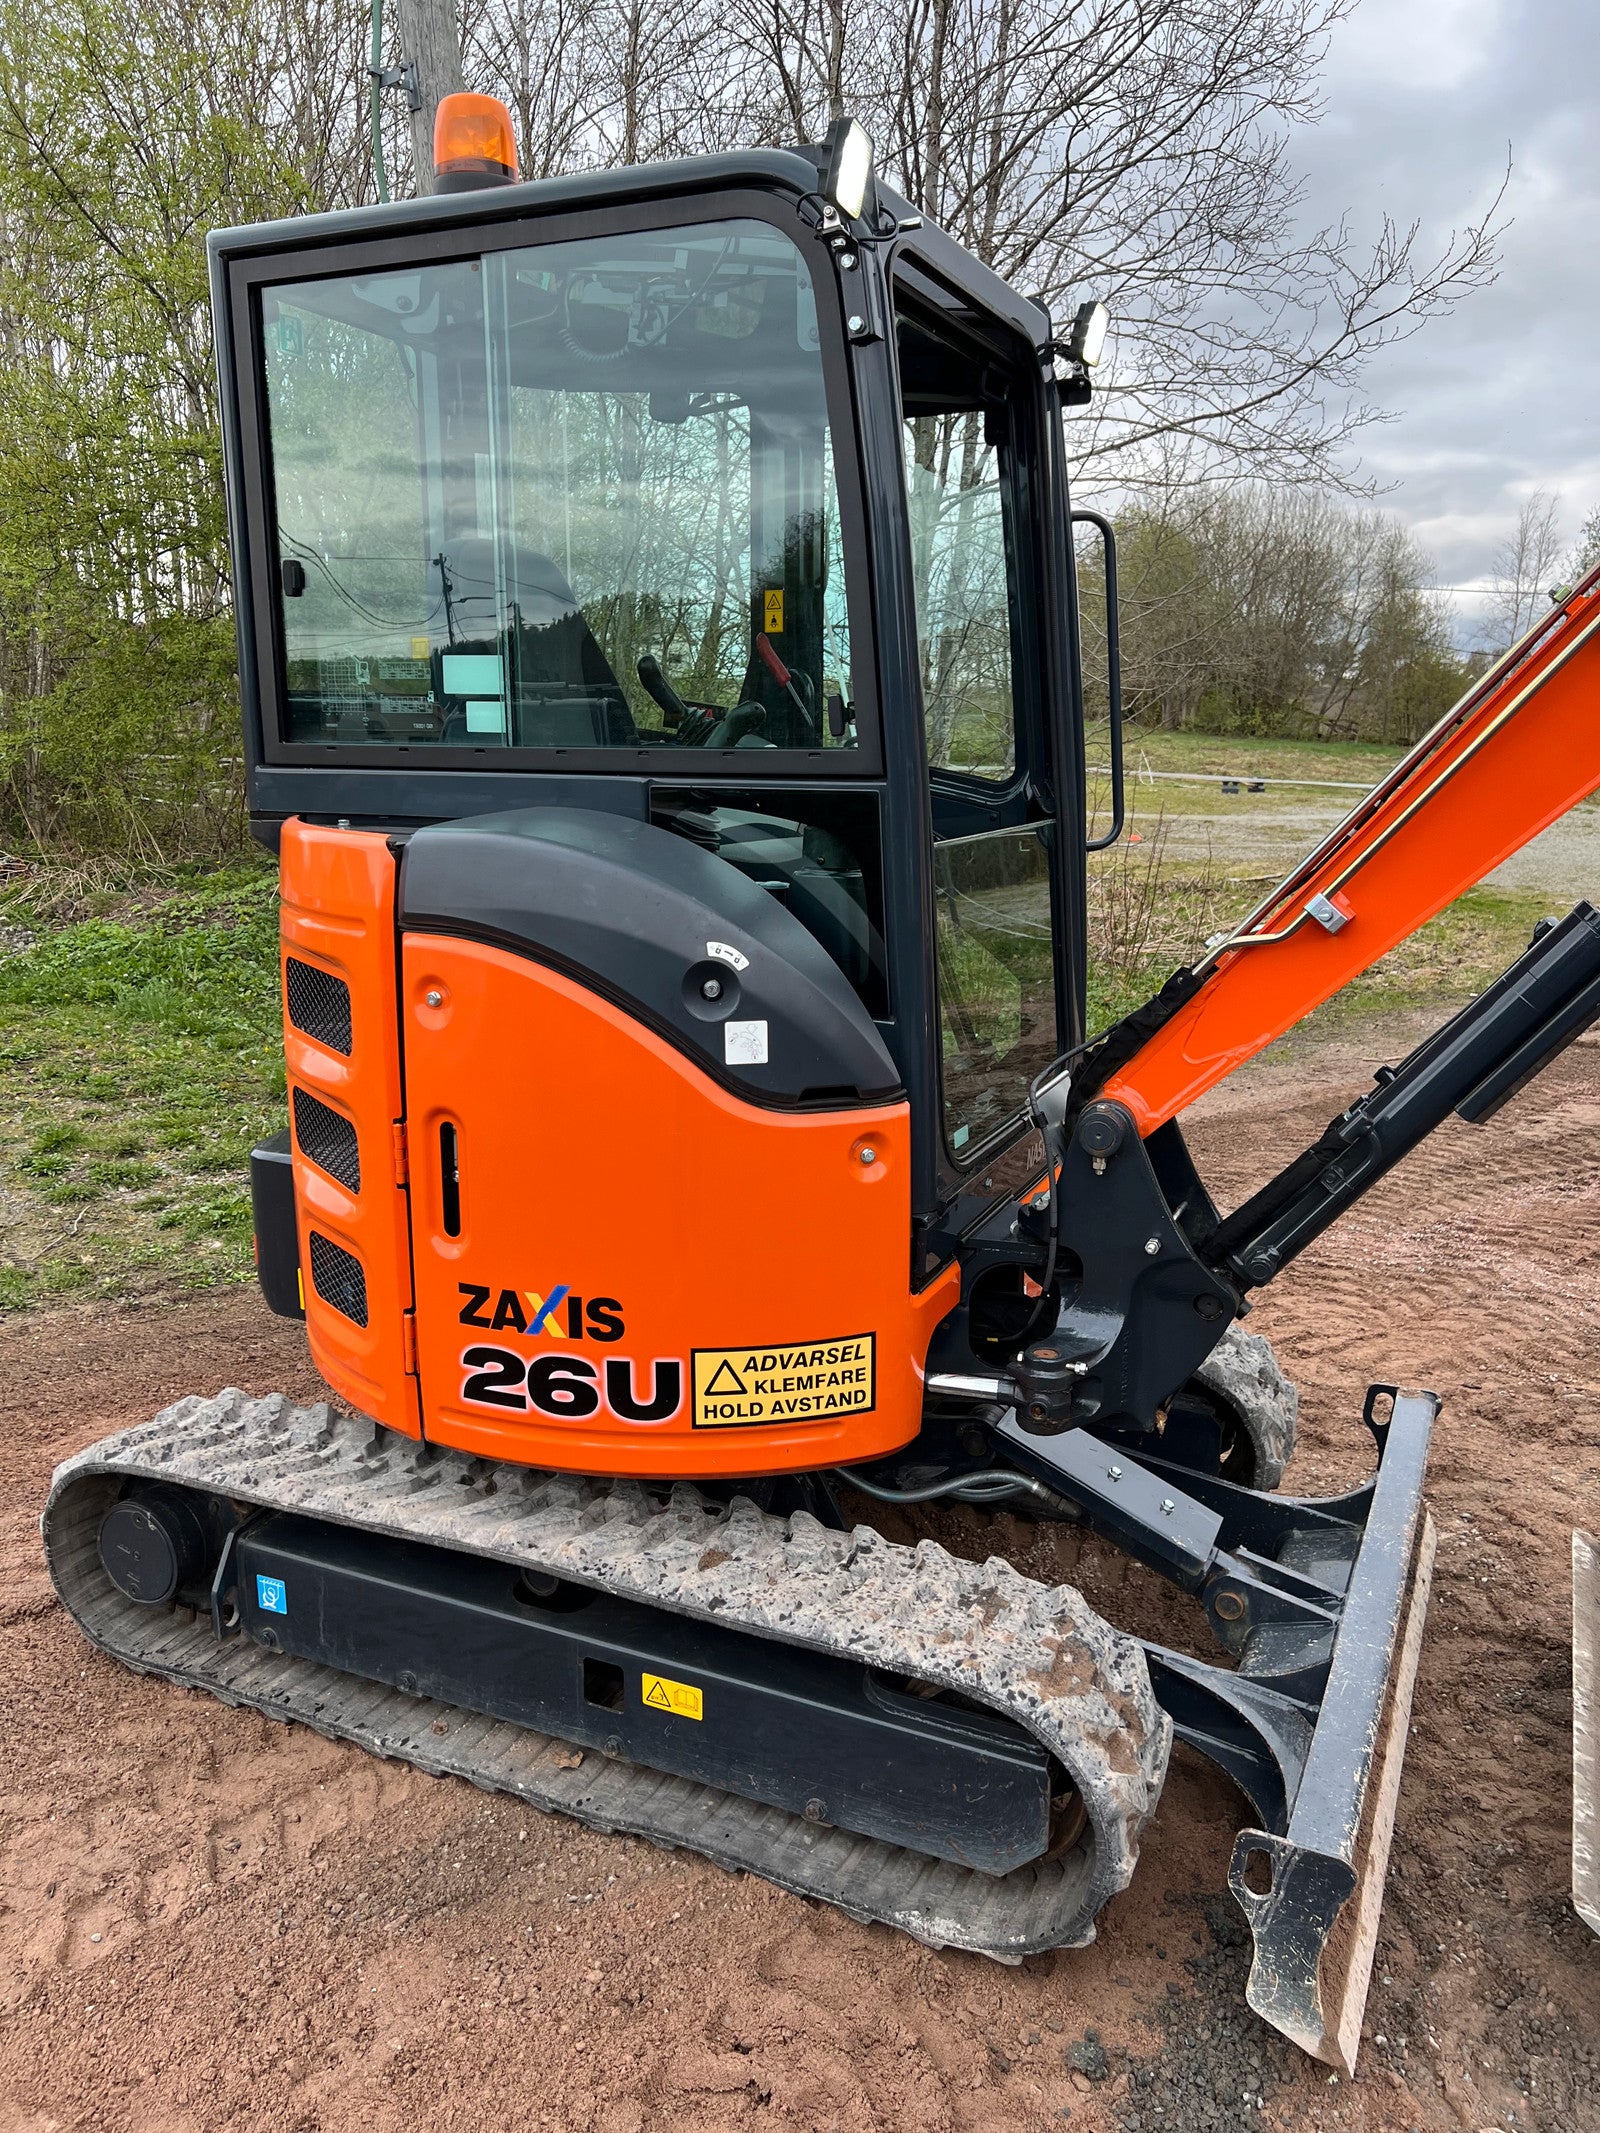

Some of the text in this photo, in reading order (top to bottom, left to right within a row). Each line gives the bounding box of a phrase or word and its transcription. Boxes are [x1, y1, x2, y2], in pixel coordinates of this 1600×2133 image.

[458, 1282, 625, 1342] ZAXIS
[742, 1344, 866, 1373] ADVARSEL
[462, 1346, 681, 1421] 26U
[754, 1367, 867, 1395] KLEMFARE
[704, 1389, 867, 1419] HOLD AVSTAND
